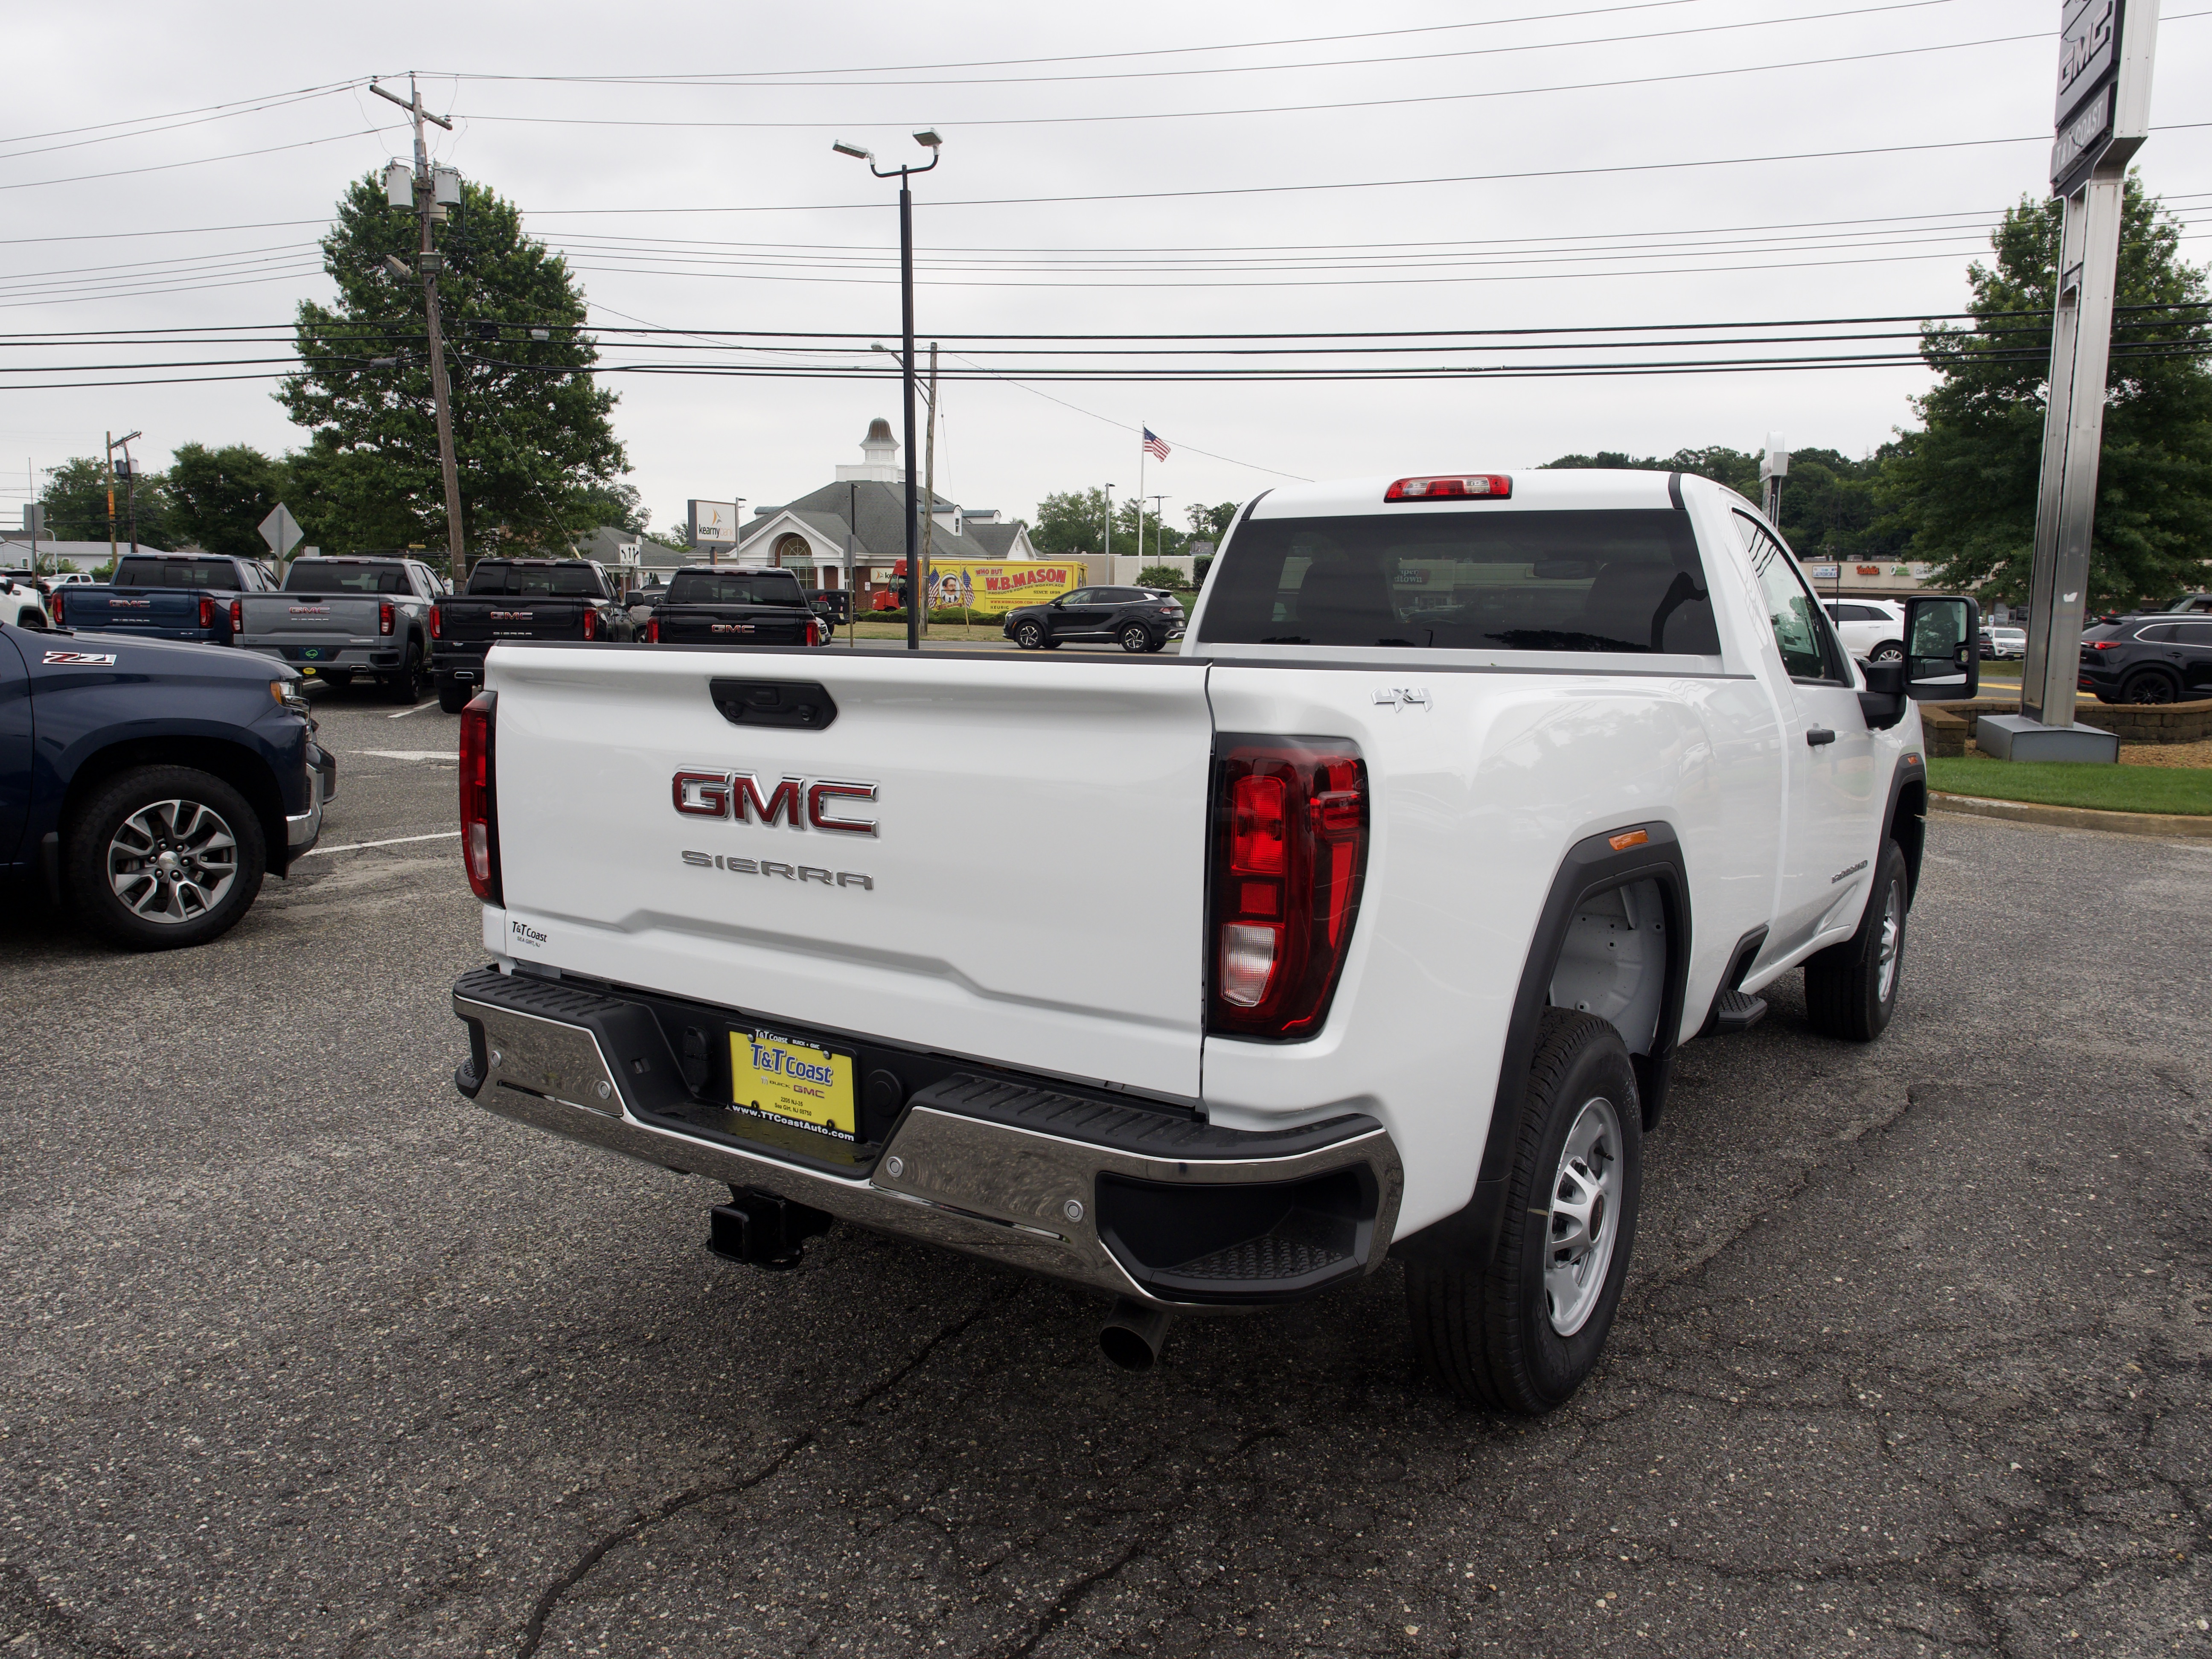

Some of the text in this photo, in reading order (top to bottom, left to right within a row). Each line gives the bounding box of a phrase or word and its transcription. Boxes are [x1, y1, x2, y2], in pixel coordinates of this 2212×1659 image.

[2059, 1, 2113, 95] GMC
[2074, 100, 2103, 151] COAST
[110, 600, 150, 608] GMC
[289, 606, 330, 614] GMC
[491, 611, 533, 620] GMC
[711, 624, 755, 633] GMC
[42, 651, 117, 667] Z71
[672, 767, 880, 838] GMC
[681, 849, 874, 891] SIERRA
[512, 921, 547, 942] T&T Coast
[755, 1029, 770, 1039] T&T
[768, 1033, 789, 1044] Coast
[750, 1042, 834, 1086] T&T Coast
[769, 1080, 825, 1099] BUICK GMC
[733, 1104, 855, 1142] www.TTCoastAuto.com
